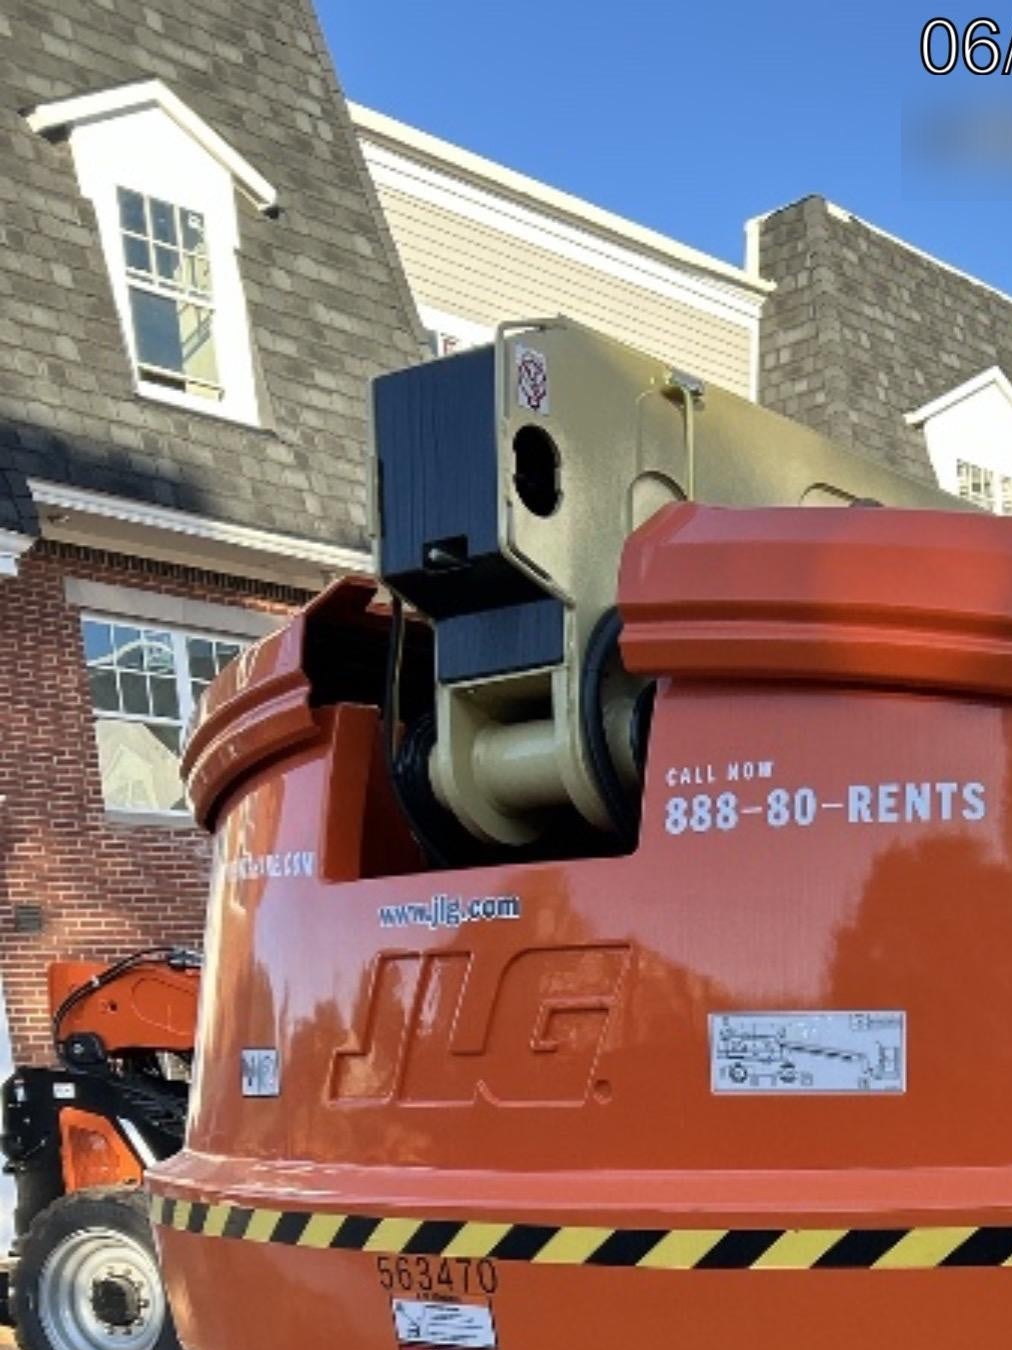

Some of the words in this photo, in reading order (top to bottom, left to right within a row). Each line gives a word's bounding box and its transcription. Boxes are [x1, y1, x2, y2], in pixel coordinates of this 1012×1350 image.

[665, 764, 717, 786] CALL
[726, 760, 775, 781] NOW
[664, 782, 986, 835] 888-80-RENTS
[378, 894, 521, 930] www.jlg.com
[376, 1255, 498, 1294] 563470
